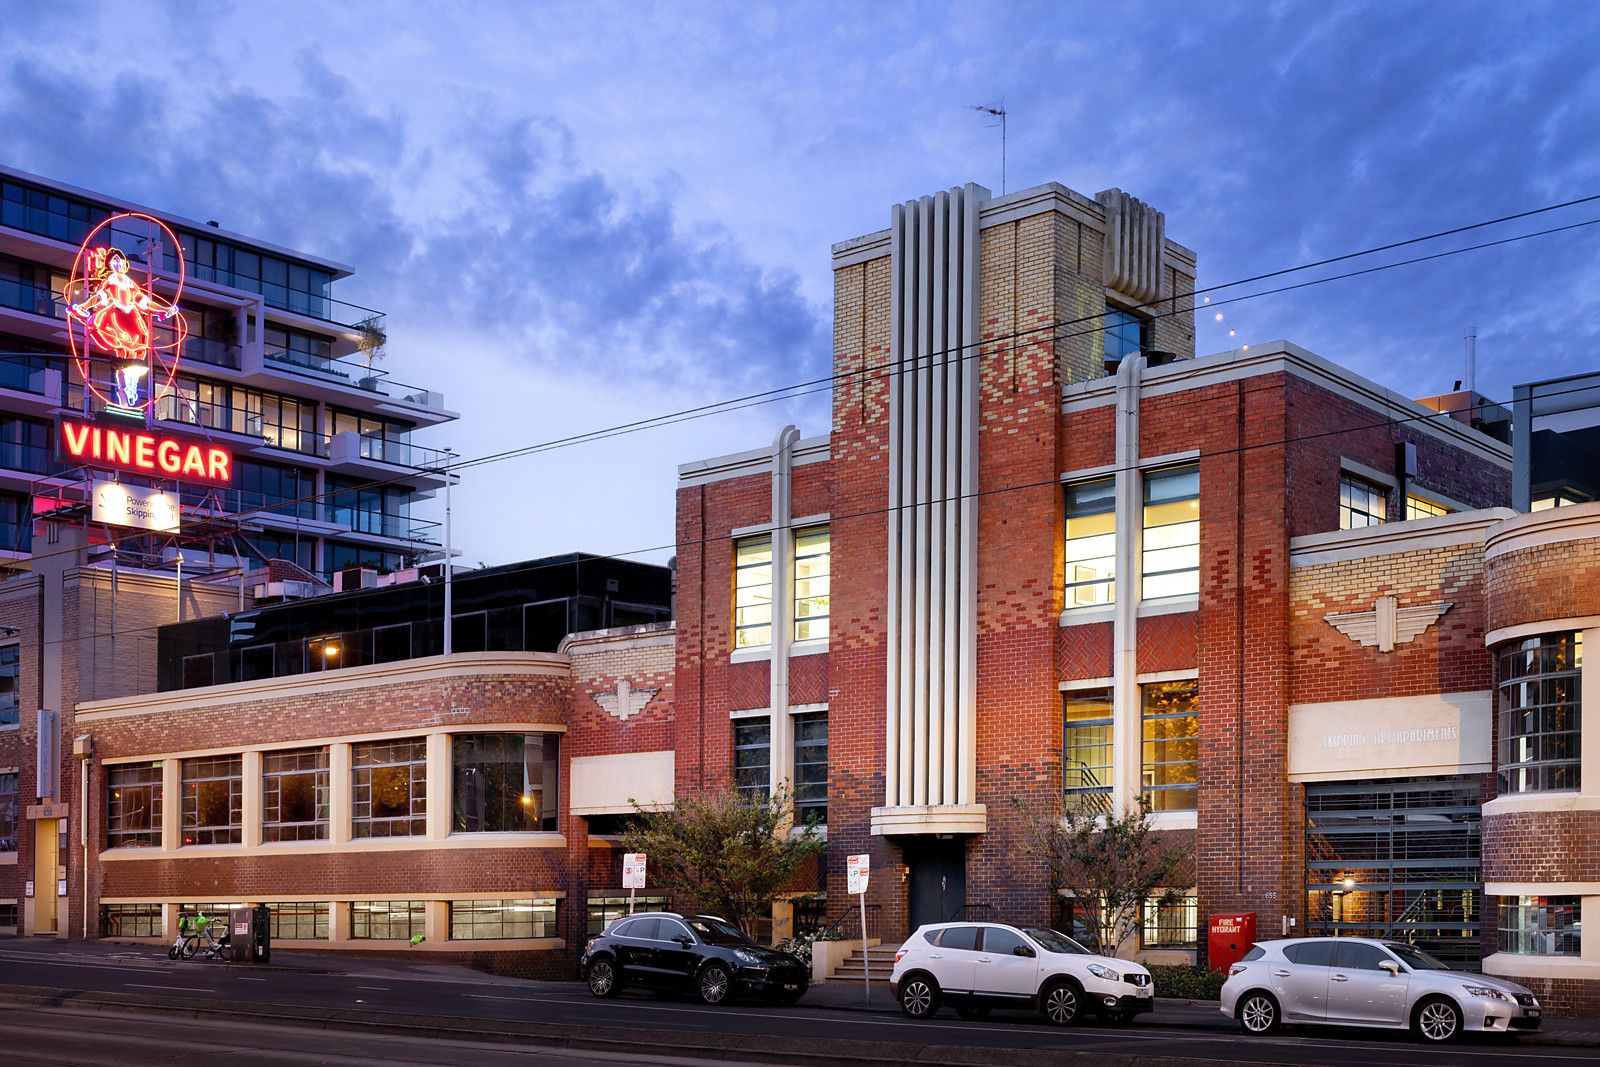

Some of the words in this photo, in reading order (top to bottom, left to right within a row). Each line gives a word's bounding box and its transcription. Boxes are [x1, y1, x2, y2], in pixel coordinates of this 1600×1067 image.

[63, 421, 229, 482] VINEGAR
[126, 506, 157, 521] Skippin
[1397, 726, 1458, 743] APARTMENTS
[1211, 925, 1241, 933] HYDRANT
[1218, 918, 1234, 926] FIRE
